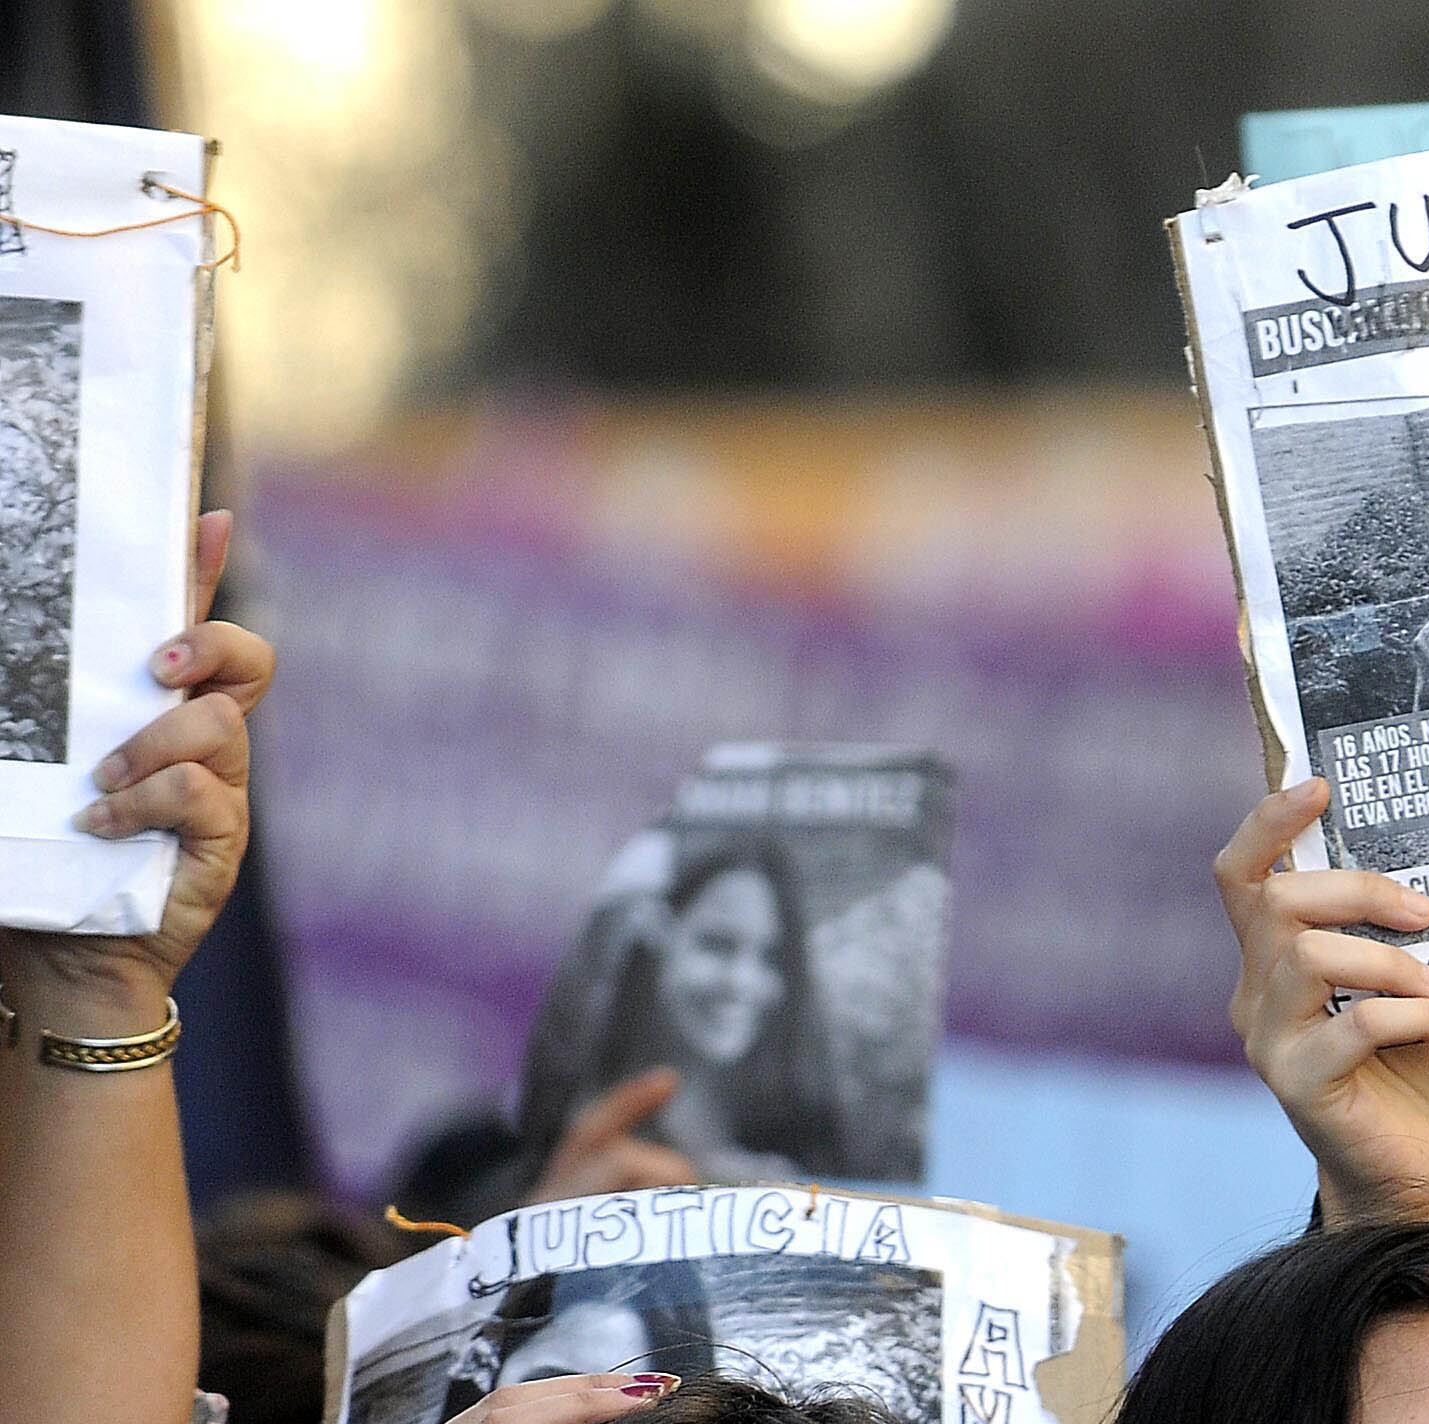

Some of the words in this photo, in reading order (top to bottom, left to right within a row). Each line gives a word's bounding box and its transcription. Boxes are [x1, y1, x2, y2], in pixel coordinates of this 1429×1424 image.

[1334, 735, 1356, 759] 16
[1363, 725, 1417, 748] AÑOS.
[1336, 758, 1371, 782] LAS
[1379, 751, 1399, 773] 17
[1339, 779, 1375, 805] FUE
[1376, 774, 1402, 799] EN
[1404, 770, 1428, 790] EL
[468, 1185, 911, 1299] JUSTICIA
